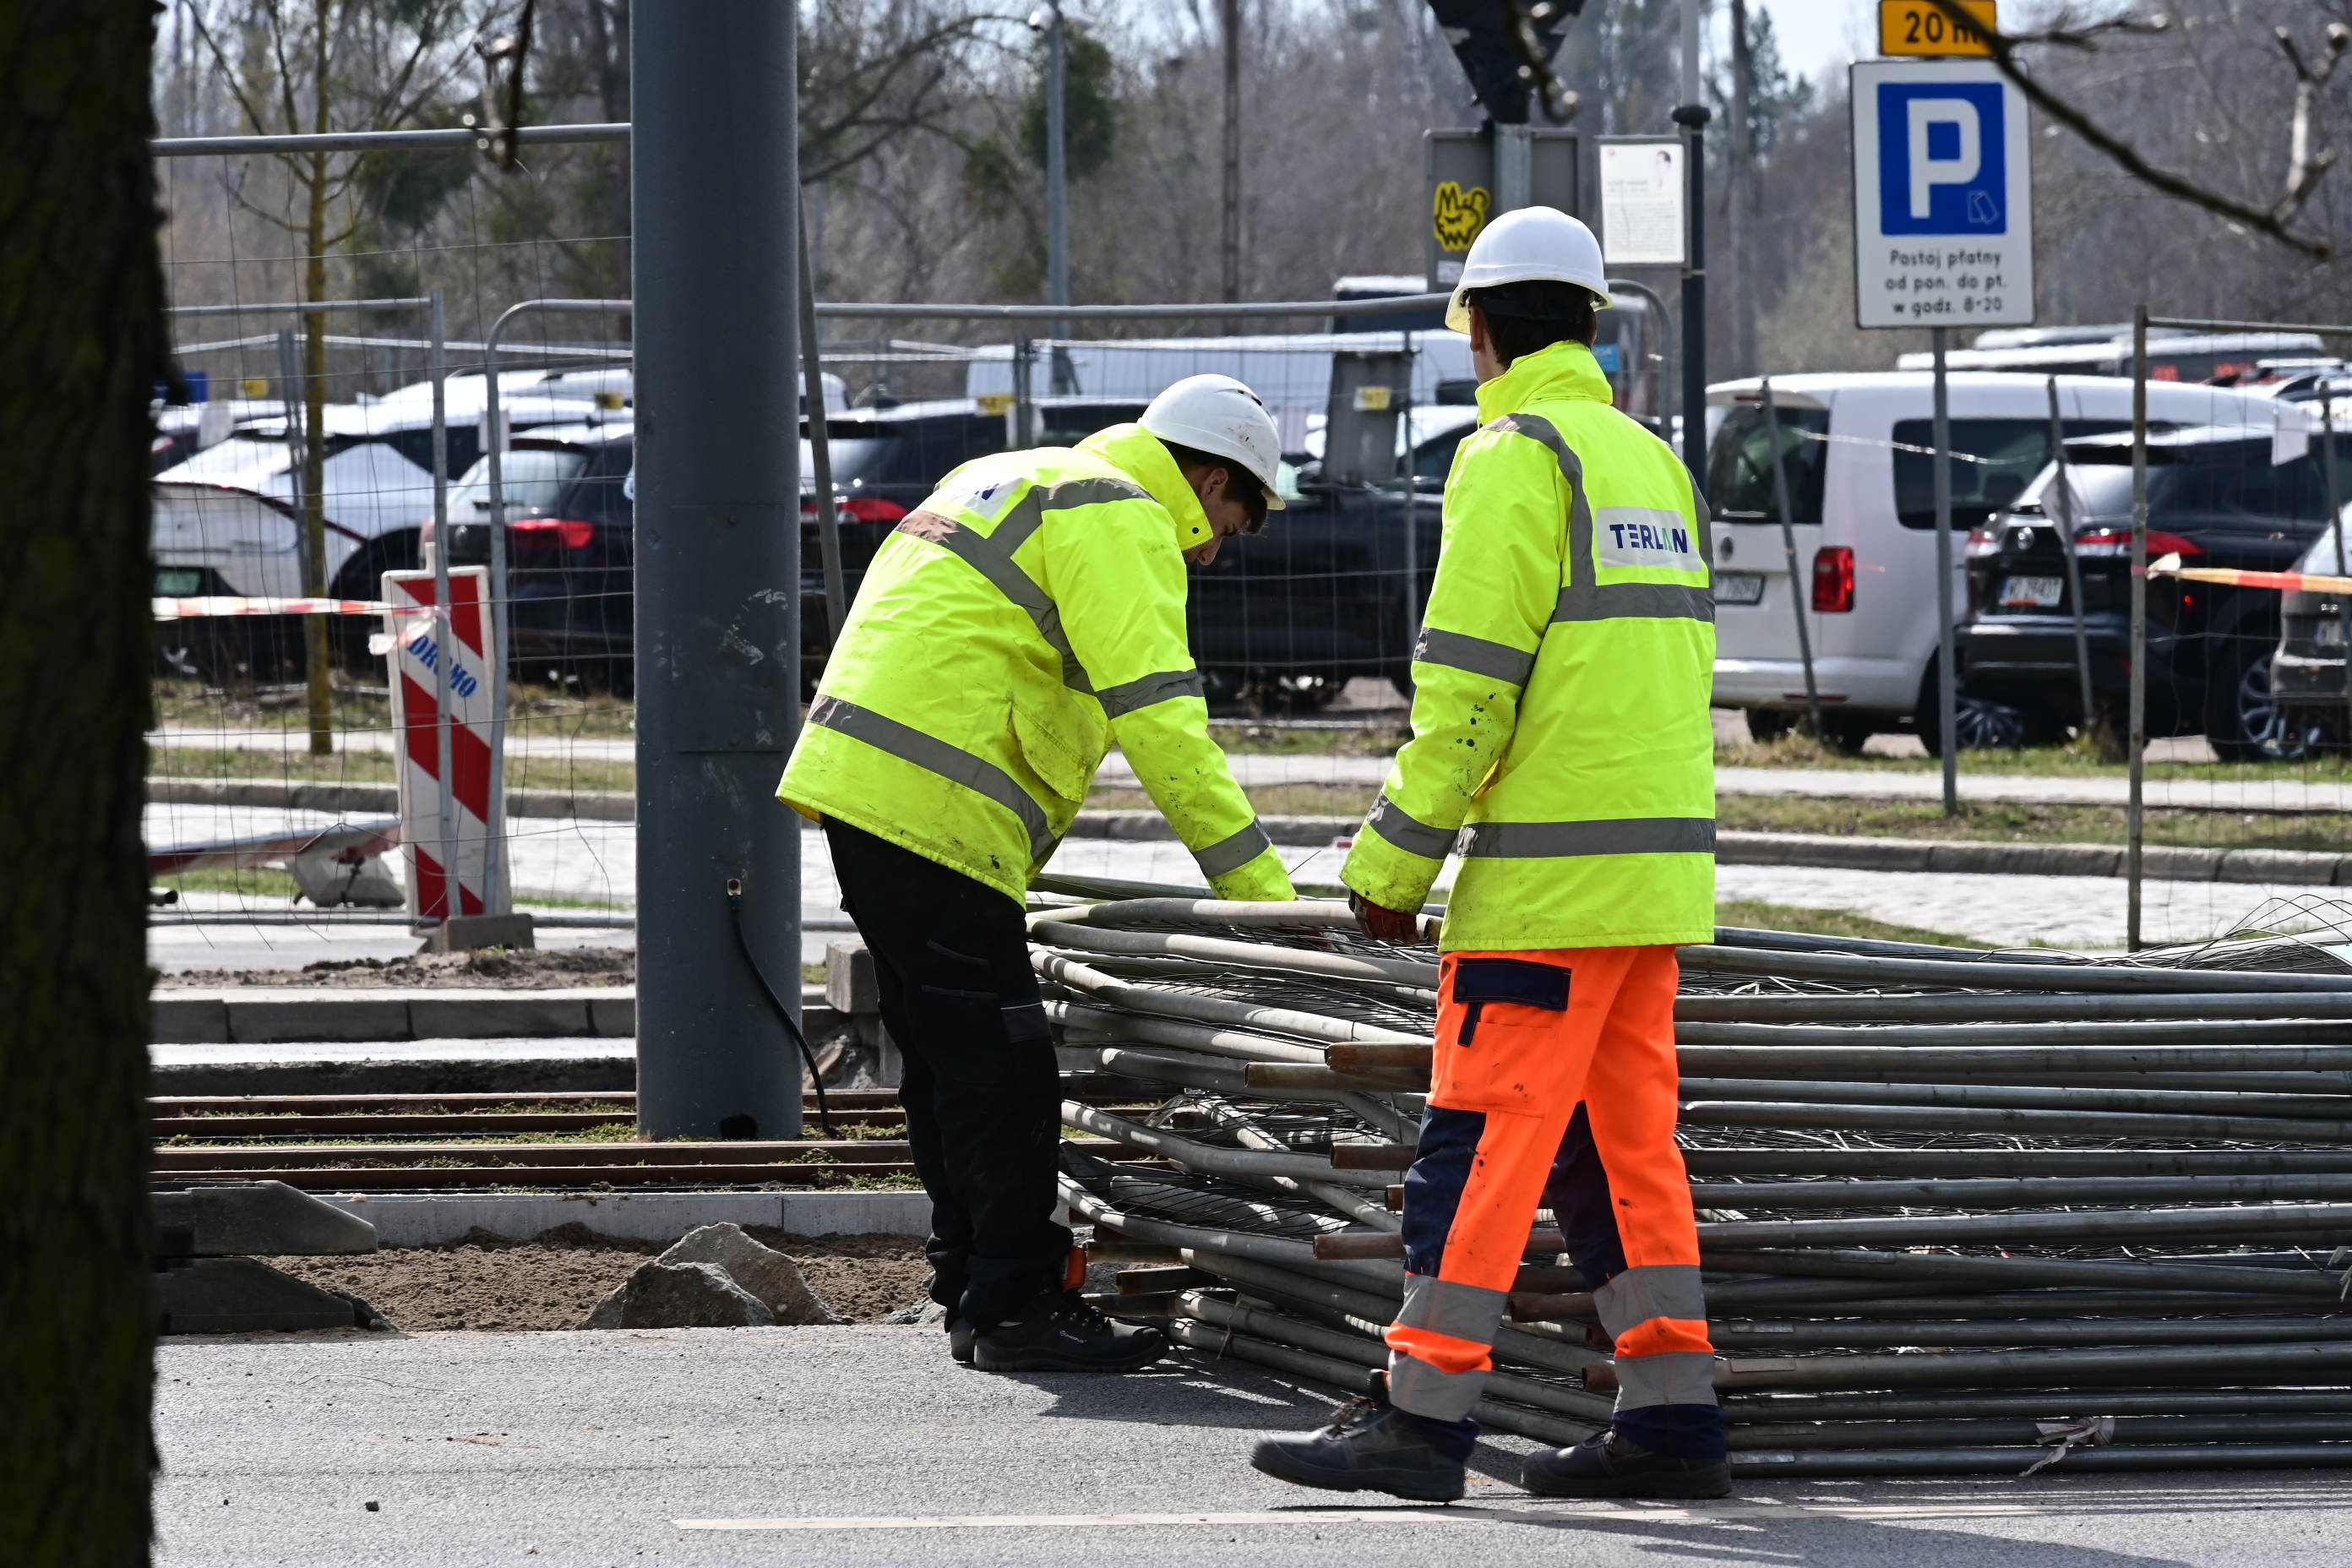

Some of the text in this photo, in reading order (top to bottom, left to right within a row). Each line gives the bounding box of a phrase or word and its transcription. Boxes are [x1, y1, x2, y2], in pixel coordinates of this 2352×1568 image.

[1905, 11, 1943, 43] 20
[1907, 98, 1981, 219] P
[1885, 275, 1907, 291] od
[1914, 276, 1950, 294] pon.
[1957, 273, 1979, 290] do
[1893, 302, 1905, 313] w
[1911, 297, 1956, 318] godz.
[1609, 523, 1688, 553] TERLAN
